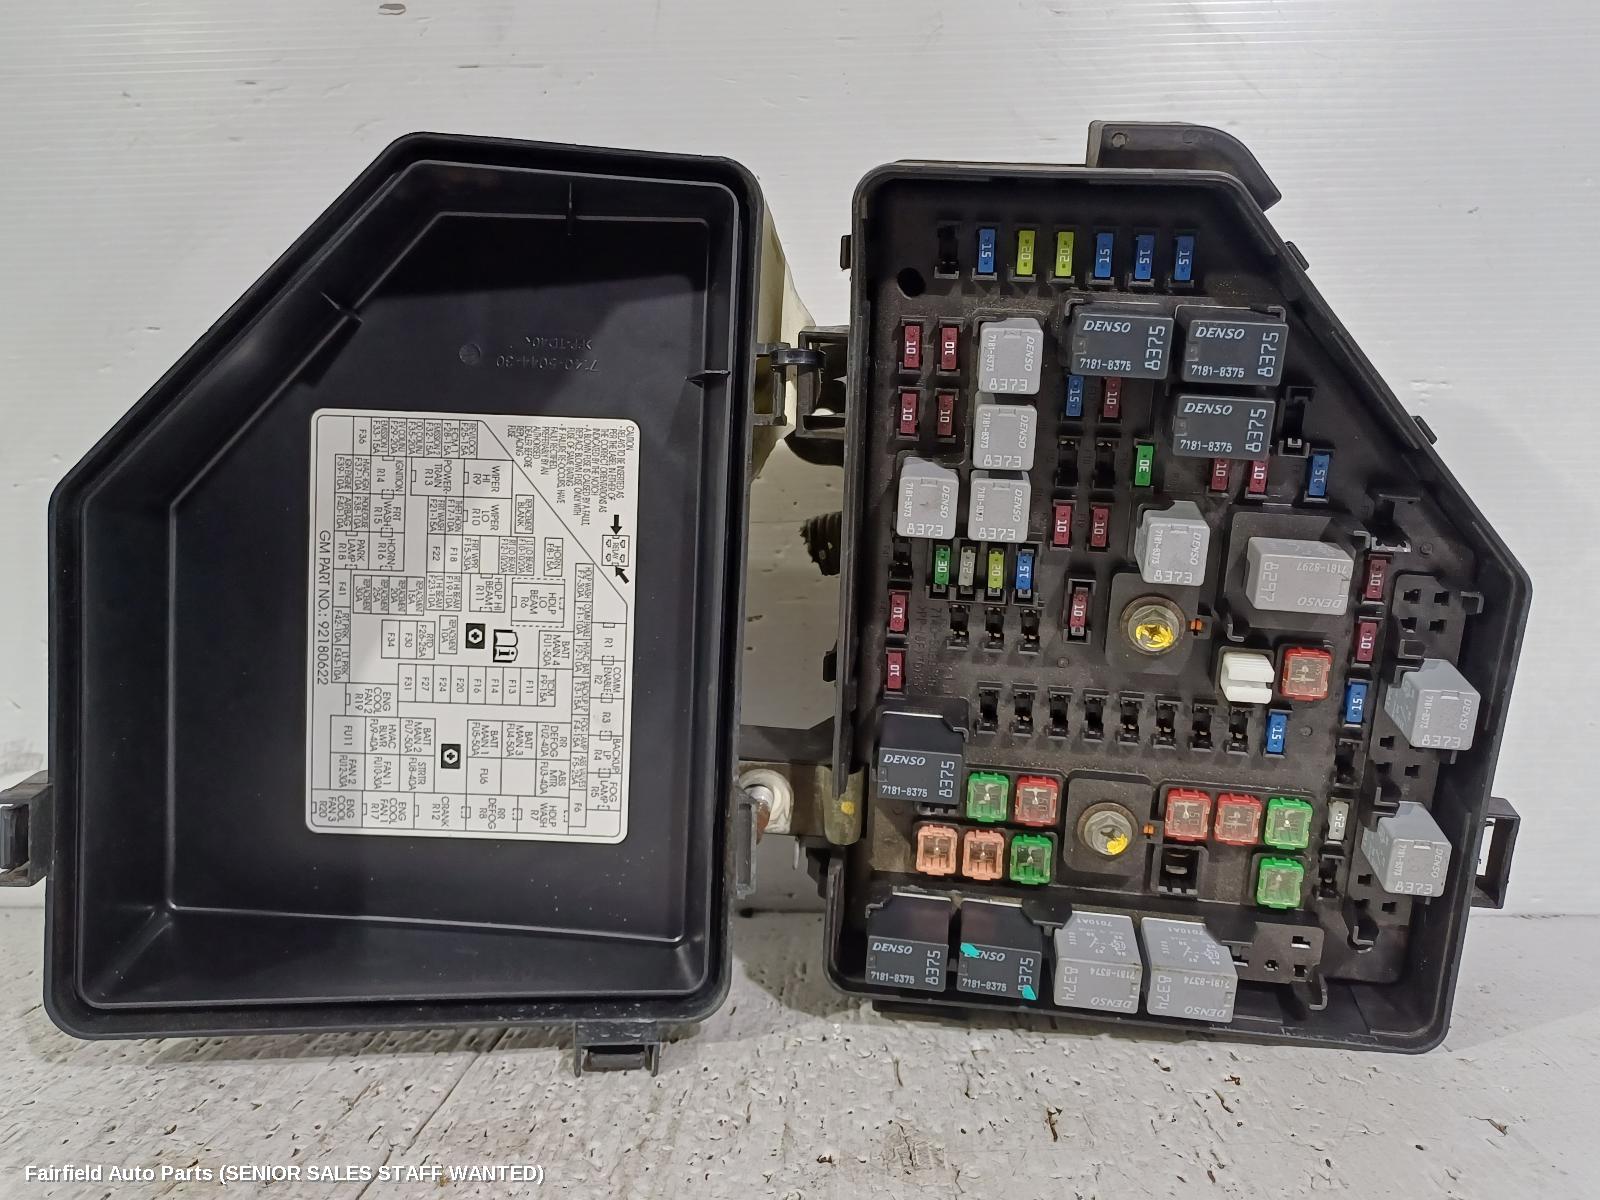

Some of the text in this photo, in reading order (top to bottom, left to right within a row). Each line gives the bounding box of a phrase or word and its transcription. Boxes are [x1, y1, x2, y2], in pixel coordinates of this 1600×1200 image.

[981, 244, 991, 258] 15
[1022, 246, 1032, 260] 20
[1060, 248, 1070, 262] 20
[1100, 248, 1110, 262] 15
[1140, 250, 1150, 264] 15
[1179, 251, 1189, 265] 15
[1083, 320, 1131, 333] DENSO
[1195, 326, 1244, 340] DENSO
[906, 341, 916, 354] 10
[944, 342, 954, 356] 10
[1024, 336, 1035, 371] DENSO
[1144, 326, 1166, 370] 8375
[1258, 332, 1279, 378] 8375
[1080, 358, 1132, 370] 7181-8375
[1191, 365, 1244, 378] 7181-8375
[989, 378, 1028, 392] 8373
[1070, 388, 1080, 403] 15
[1106, 392, 1117, 404] 10
[902, 408, 912, 421] 10
[1184, 402, 1232, 415] DENSO
[940, 410, 950, 422] 10
[1018, 415, 1028, 448] DENSO
[1246, 408, 1266, 452] 8375
[626, 426, 634, 450] CAUTION
[1180, 440, 1232, 452] 7181-8375
[984, 454, 1022, 468] 8373
[1139, 460, 1148, 472] 30
[377, 468, 385, 482] R14
[434, 464, 442, 488] TRAIN
[1216, 464, 1226, 476] 10
[1254, 466, 1264, 479] 10
[1314, 469, 1325, 483] 15
[473, 473, 481, 485] R9
[483, 474, 490, 483] HI
[491, 466, 500, 492] WIPER
[940, 485, 950, 518] DENSO
[1013, 488, 1022, 522] DENSO
[374, 507, 382, 524] R15
[383, 501, 391, 526] WASH
[393, 507, 401, 521] FRT
[472, 509, 480, 525] R10
[482, 510, 489, 522] LO
[490, 505, 499, 530] WIPER
[906, 522, 944, 536] 8373
[1057, 519, 1067, 532] 10
[1094, 521, 1104, 534] 10
[978, 528, 1016, 540] 8373
[338, 543, 346, 560] R18
[357, 540, 365, 561] PARK
[378, 543, 386, 560] R16
[387, 539, 396, 565] HORN
[432, 546, 440, 561] F22
[1191, 532, 1200, 566] DENSO
[938, 560, 947, 572] 30
[963, 561, 972, 574] 25
[992, 565, 1000, 576] 20
[1020, 566, 1029, 578] 15
[1154, 570, 1192, 583] 8373
[1260, 562, 1279, 602] 8297
[1370, 572, 1382, 586] 10
[338, 582, 346, 595] F41
[476, 586, 484, 601] R11
[318, 530, 331, 685] GM PART NO.: 92180622
[520, 596, 529, 608] R6
[530, 590, 538, 614] BEAM
[539, 596, 547, 608] LO
[548, 593, 556, 614] HDLP
[1297, 597, 1342, 608] DENSO
[893, 607, 902, 619] 10
[1074, 604, 1084, 616] 10
[604, 638, 613, 648] R1
[1360, 636, 1372, 648] 10
[562, 641, 570, 659] BATT
[890, 664, 900, 676] 10
[456, 678, 464, 692] F20
[526, 680, 534, 693] F11
[594, 675, 602, 684] R2
[604, 667, 612, 692] ENABLE
[613, 667, 621, 693] COMM
[1353, 698, 1362, 710] 15
[602, 712, 610, 723] R3
[1459, 699, 1472, 730] DENSO
[1272, 728, 1283, 740] 15
[550, 726, 558, 757] DEFOG
[560, 736, 567, 748] RR
[1421, 735, 1461, 749] 8373
[594, 750, 602, 760] R4
[604, 750, 611, 760] LP
[883, 754, 926, 766] DENSO
[418, 762, 426, 784] STRTR
[480, 768, 488, 784] FU6
[550, 770, 558, 787] MTR
[558, 770, 567, 786] ABS
[939, 761, 954, 798] 8375
[591, 786, 599, 798] R5
[600, 780, 608, 803] LAMP
[609, 782, 618, 802] FOG
[882, 785, 928, 797] 7181-8375
[371, 803, 379, 819] R17
[389, 798, 397, 824] COOL
[398, 802, 406, 821] ENG
[432, 804, 440, 820] R12
[441, 796, 449, 827] CRANK
[479, 808, 487, 819] R8
[488, 798, 496, 829] DEFOG
[498, 808, 505, 819] RR
[574, 803, 582, 812] F6
[530, 810, 539, 821] R7
[549, 806, 557, 827] HDLP
[1335, 816, 1344, 828] 25
[1432, 848, 1443, 878] DENSO
[1395, 882, 1432, 894] 8373
[872, 942, 912, 954] DENSO
[925, 950, 940, 985] 8375
[1089, 967, 1135, 980] 7181-8374
[871, 971, 914, 984] 7181-8375
[1062, 966, 1078, 1000] 8374
[1184, 976, 1230, 988] 7181-8374
[962, 978, 1006, 992] 7181-8375
[1155, 975, 1172, 1010] 8374
[1091, 996, 1132, 1008] DENSO
[1184, 1006, 1226, 1018] DENSO
